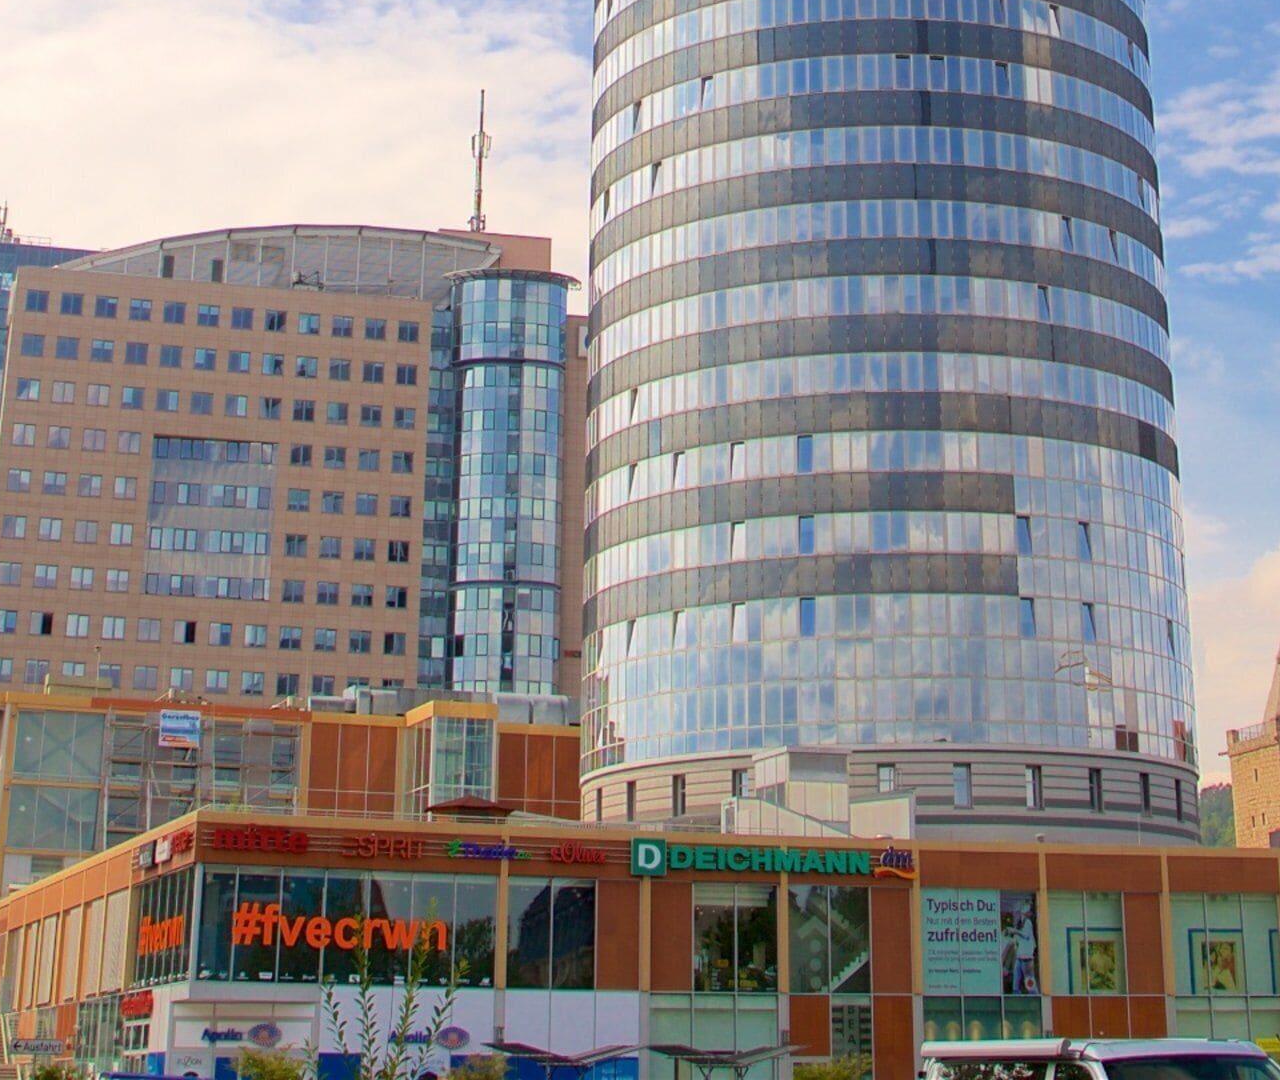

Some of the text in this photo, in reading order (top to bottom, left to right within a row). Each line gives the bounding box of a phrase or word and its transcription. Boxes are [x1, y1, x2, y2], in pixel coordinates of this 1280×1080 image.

[213, 823, 309, 855] mitte
[670, 845, 870, 875] DEICHMANN
[926, 898, 997, 914] Typisch Du:
[232, 900, 448, 951] #fvecrwn
[927, 928, 998, 942] zufrieden!
